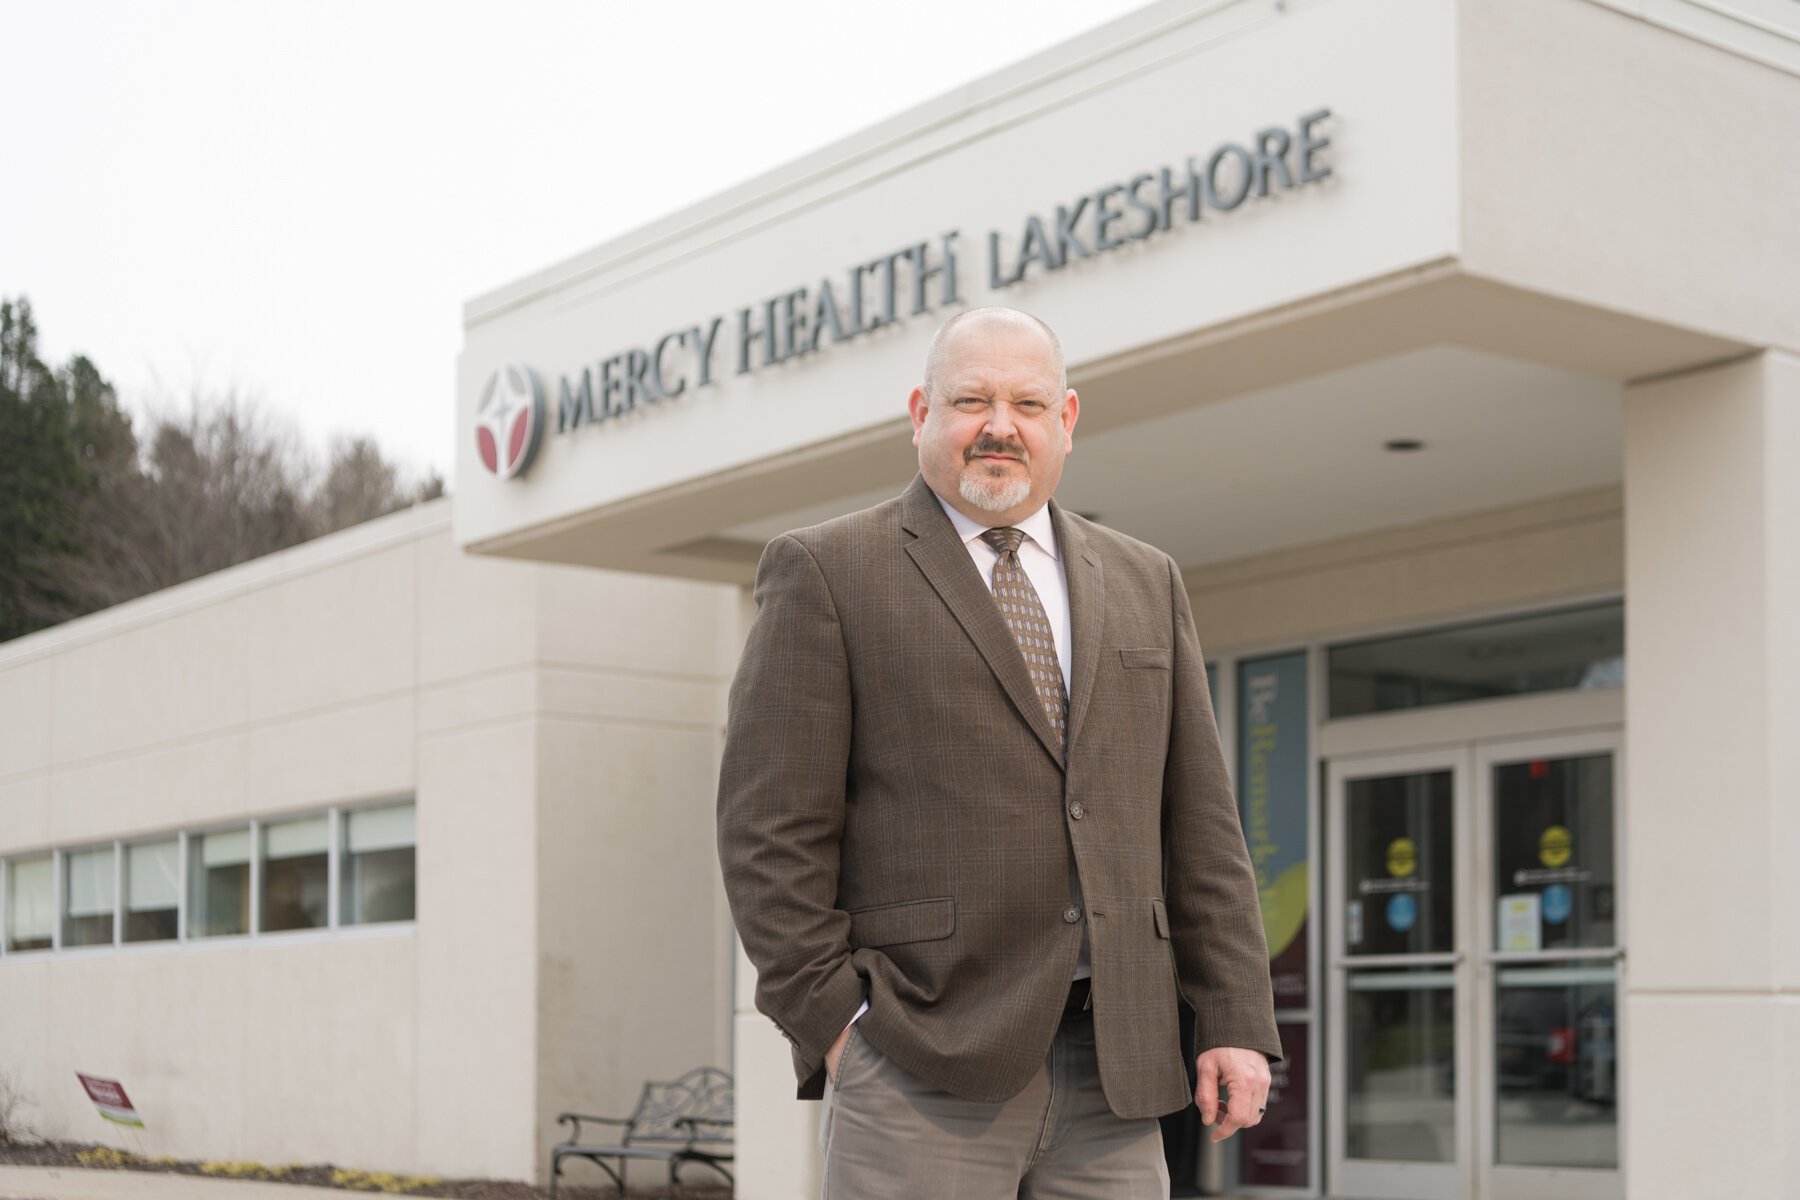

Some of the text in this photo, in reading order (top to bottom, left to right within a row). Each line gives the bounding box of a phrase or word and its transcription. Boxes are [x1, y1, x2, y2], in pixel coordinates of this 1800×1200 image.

[555, 108, 1334, 435] MERCY HEALTH LAKESHORE
